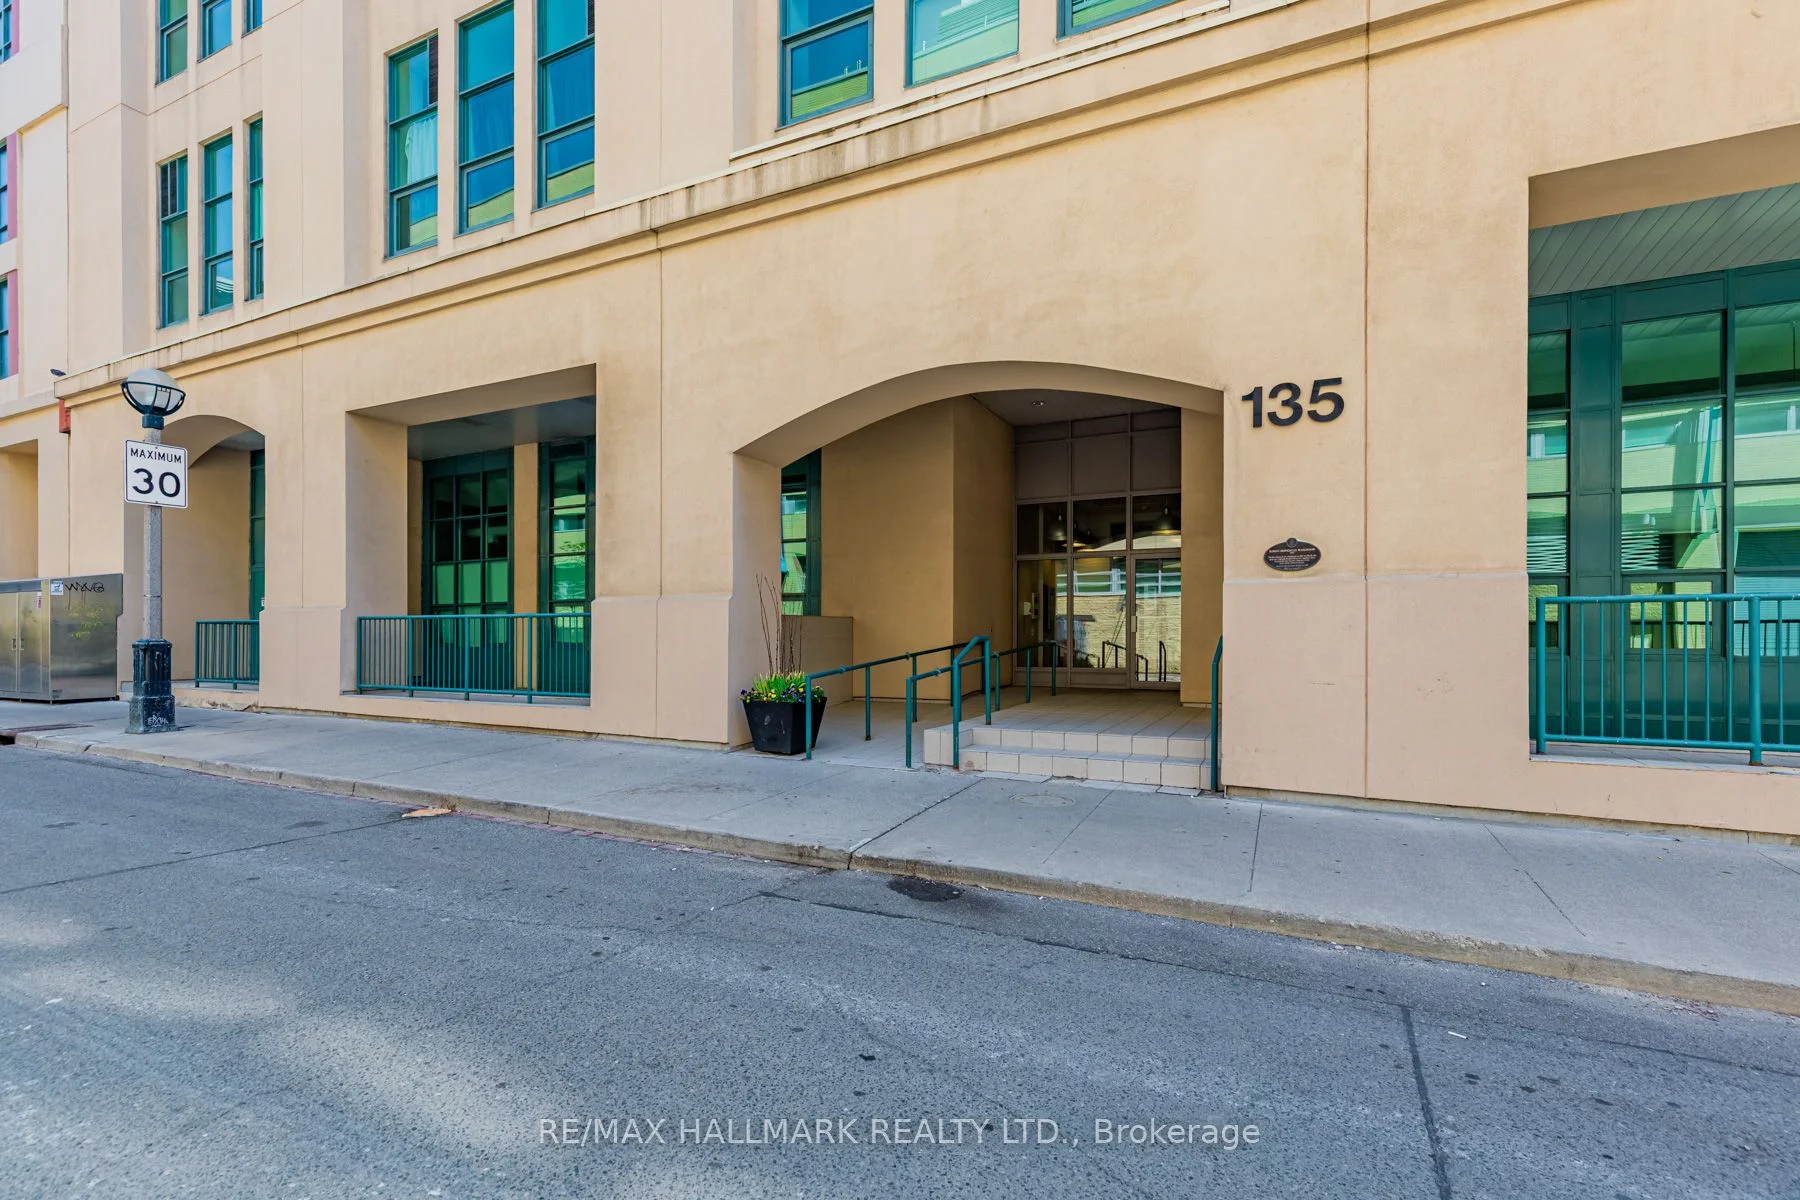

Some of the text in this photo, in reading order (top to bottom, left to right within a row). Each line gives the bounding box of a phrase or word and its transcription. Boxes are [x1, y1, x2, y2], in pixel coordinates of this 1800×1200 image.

[1241, 377, 1345, 428] 135
[130, 447, 182, 464] MAXIMUM
[132, 468, 181, 498] 30
